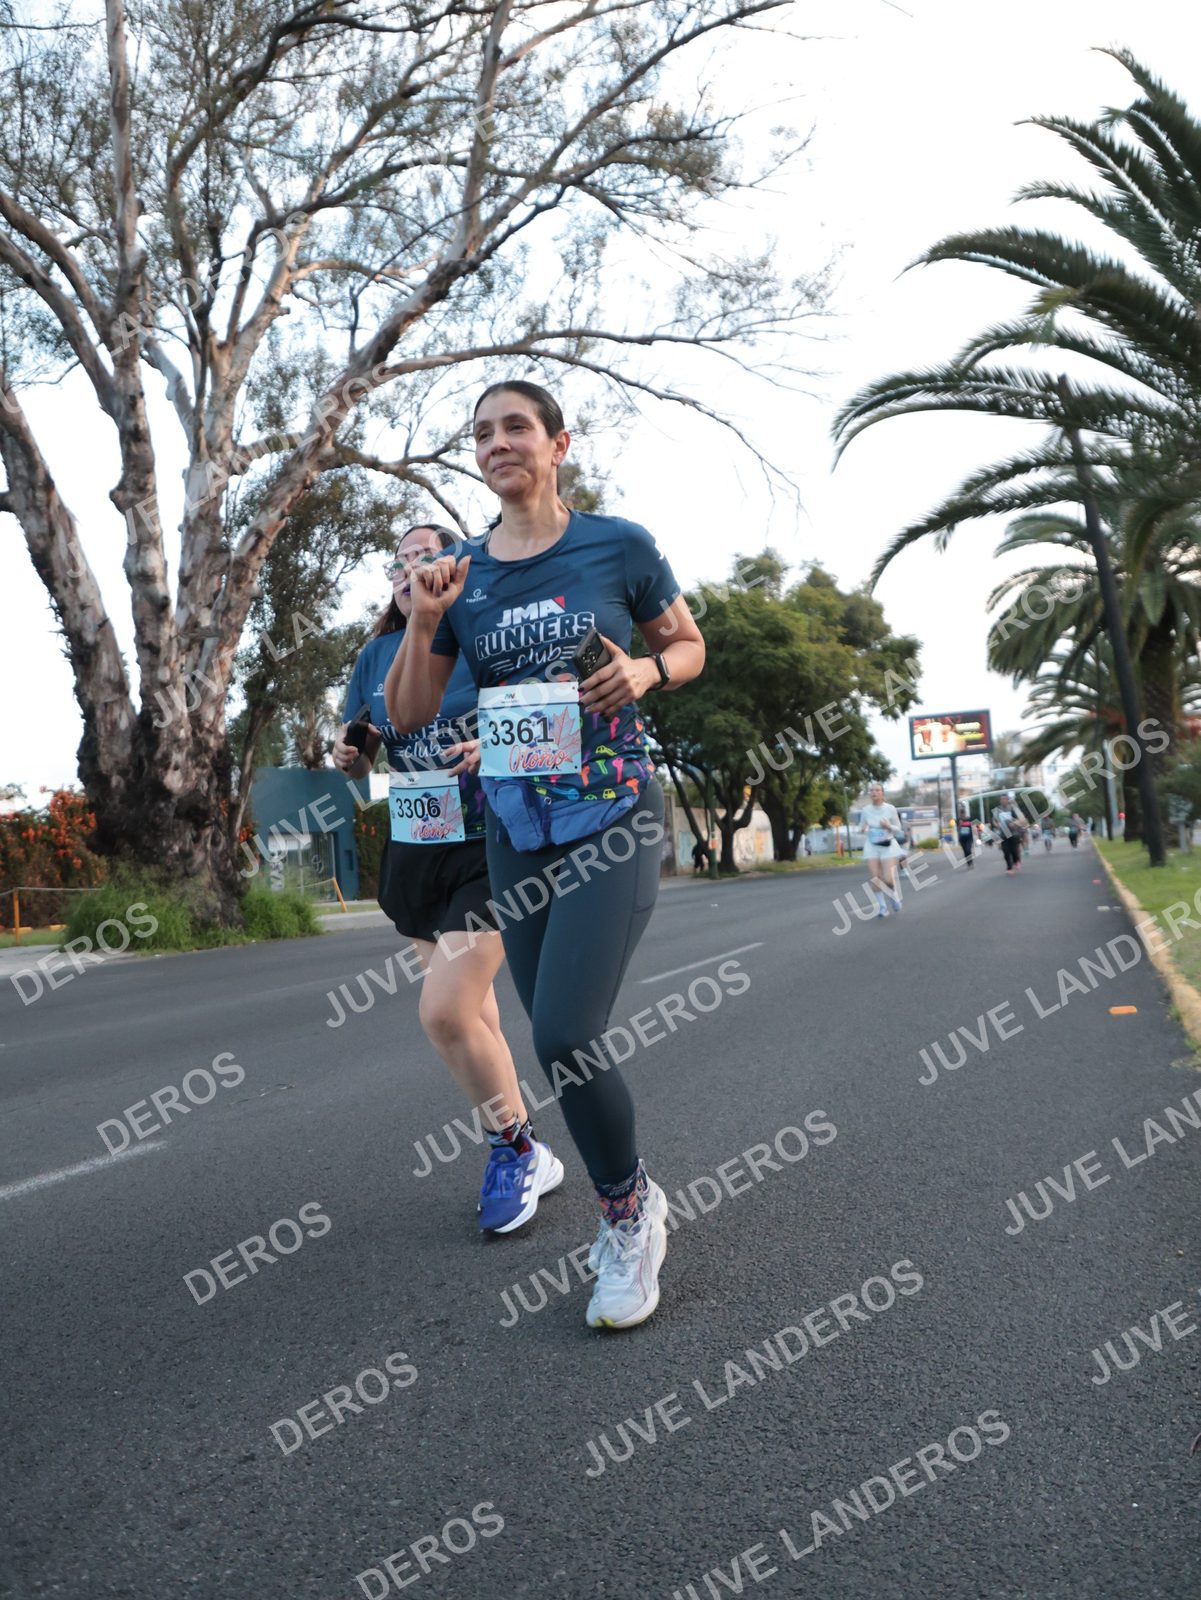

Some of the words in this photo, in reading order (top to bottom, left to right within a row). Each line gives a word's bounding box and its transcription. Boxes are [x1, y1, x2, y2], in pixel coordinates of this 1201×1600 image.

[496, 597, 565, 627] JMA
[475, 611, 594, 660] RUNNERS
[516, 644, 561, 668] club
[488, 717, 554, 746] 3361
[404, 740, 440, 758] club
[396, 797, 441, 819] 3306
